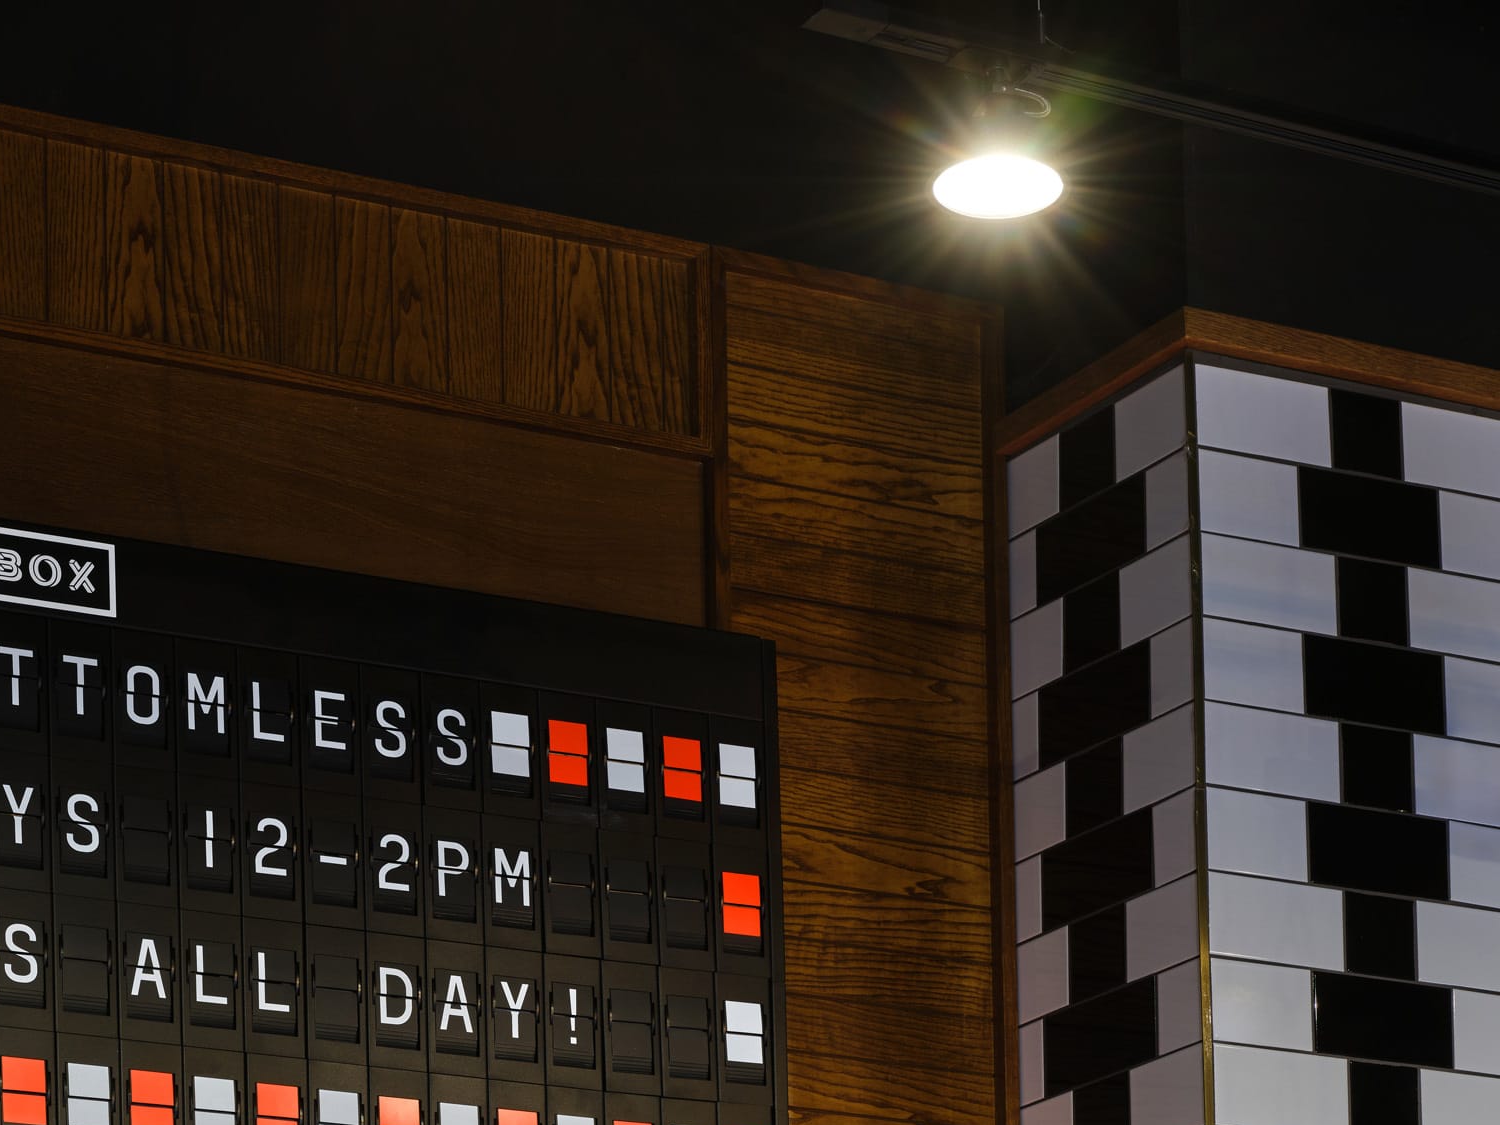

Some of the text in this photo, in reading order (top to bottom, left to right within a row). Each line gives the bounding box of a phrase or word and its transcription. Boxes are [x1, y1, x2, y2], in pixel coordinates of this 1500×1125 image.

[205, 810, 530, 908] 12-2PM
[130, 938, 290, 1013] ALL
[379, 967, 578, 1045] DAY!
